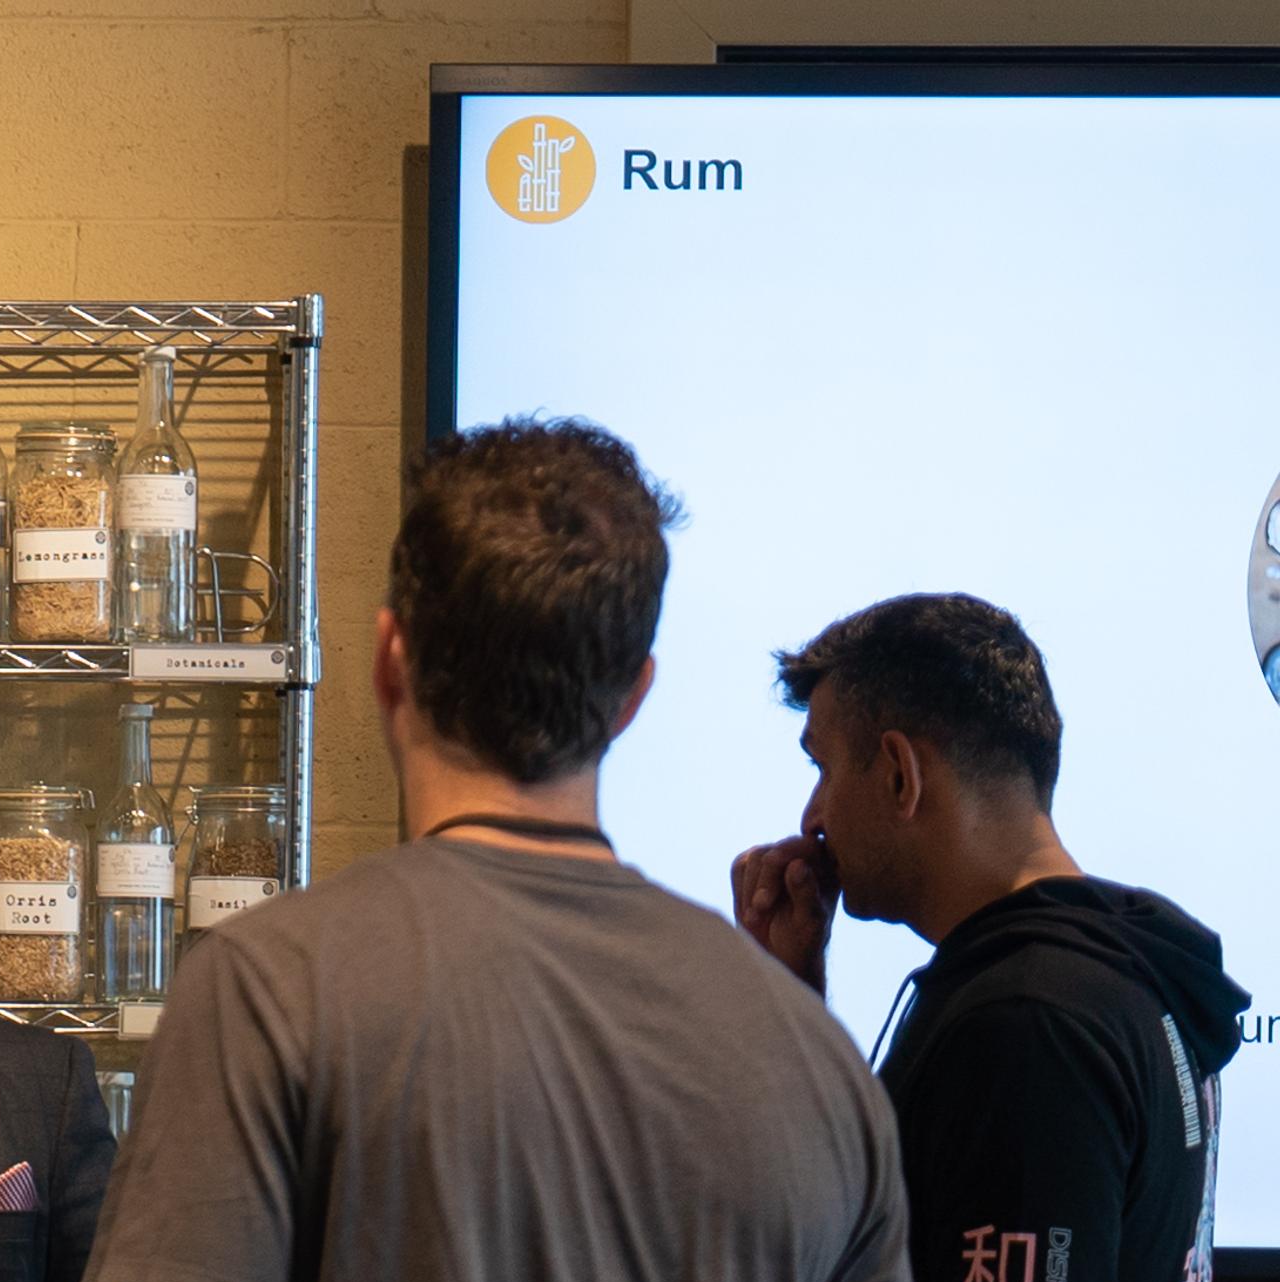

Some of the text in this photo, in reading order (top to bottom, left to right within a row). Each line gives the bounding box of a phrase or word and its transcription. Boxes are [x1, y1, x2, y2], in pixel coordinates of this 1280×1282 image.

[622, 149, 744, 191] Rum
[18, 551, 105, 563] Lemongrass
[167, 658, 246, 669] Botanicals
[6, 894, 57, 906] Orris
[210, 900, 248, 912] Basil
[12, 912, 52, 924] Root
